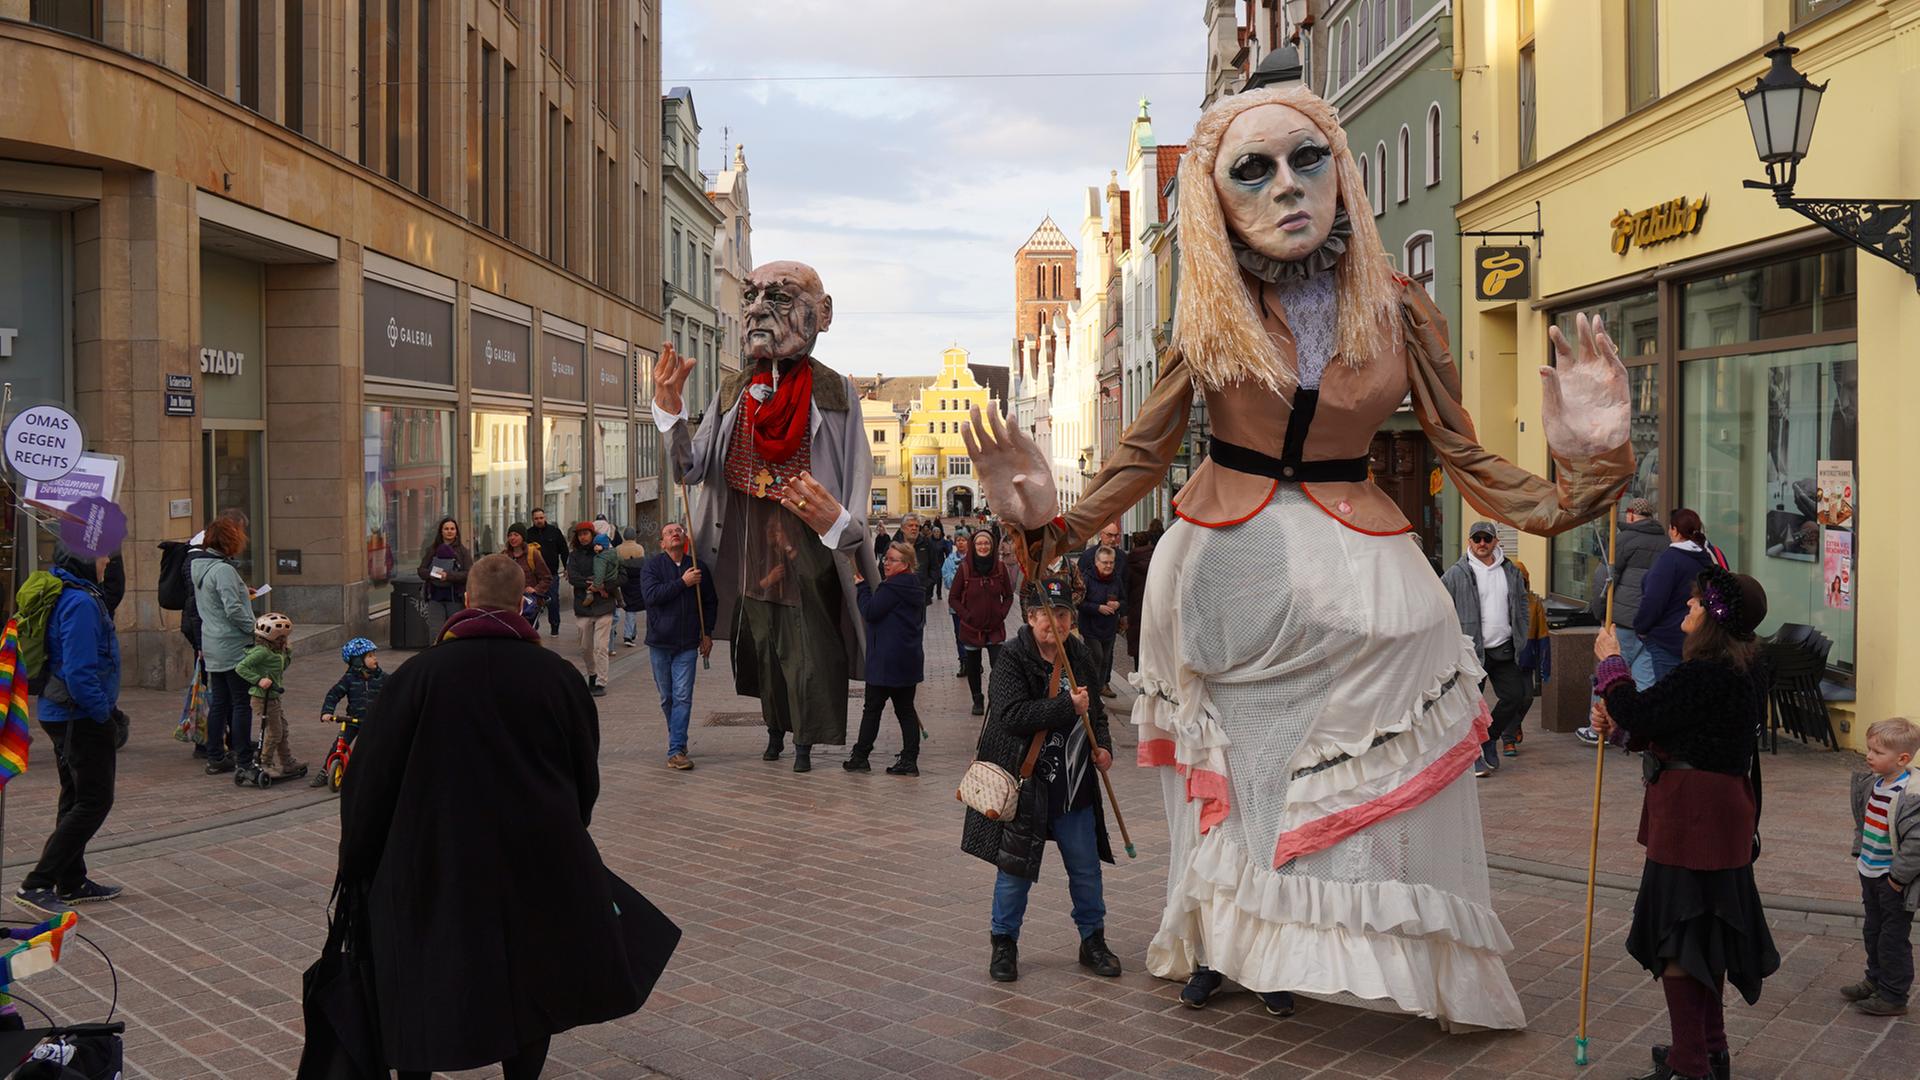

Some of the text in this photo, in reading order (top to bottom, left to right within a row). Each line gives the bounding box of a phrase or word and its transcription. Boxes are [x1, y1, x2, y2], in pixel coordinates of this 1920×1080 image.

[1632, 197, 1704, 247] Tchibo
[400, 327, 433, 348] GALERIA
[200, 347, 244, 375] STADT
[494, 348, 516, 364] GALERIA
[26, 413, 69, 430] OMAS
[18, 432, 66, 449] GEGEN
[15, 450, 69, 469] RECHTS
